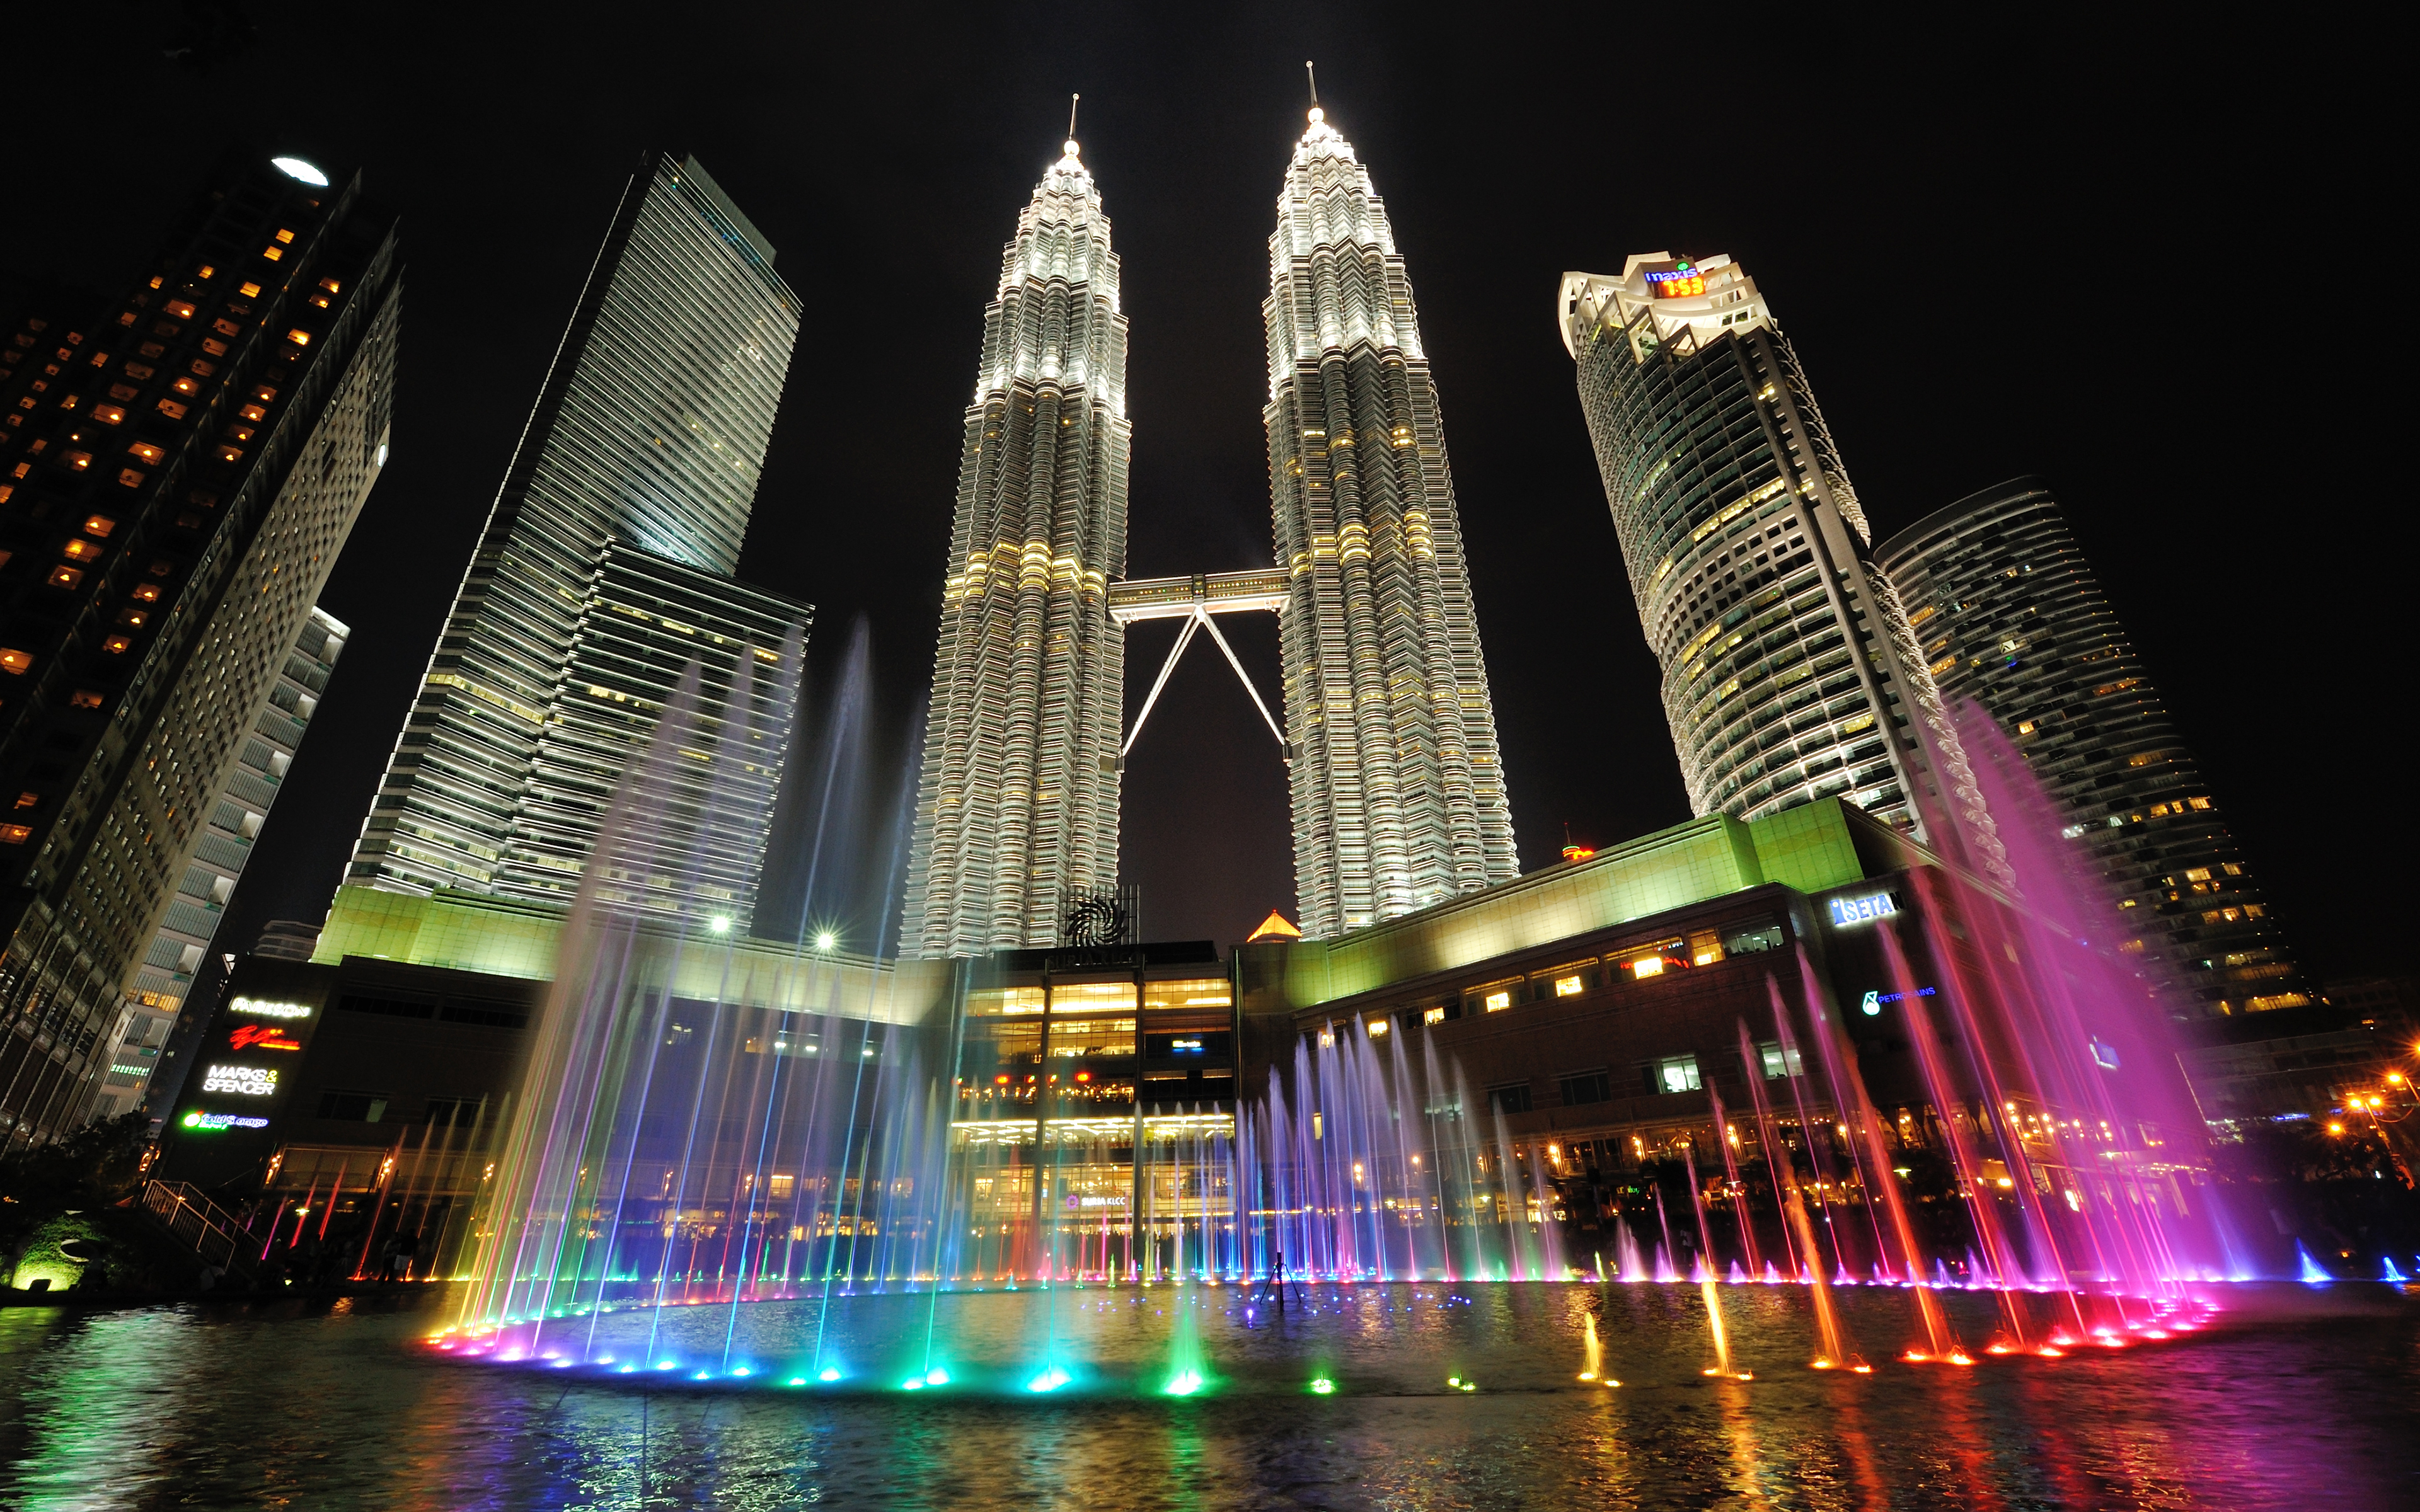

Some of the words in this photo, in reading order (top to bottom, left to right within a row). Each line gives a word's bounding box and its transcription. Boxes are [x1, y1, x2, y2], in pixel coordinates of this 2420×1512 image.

[1645, 268, 1698, 282] maxis
[1663, 277, 1703, 295] 7:53
[1878, 987, 1935, 1004] PETROSAINS
[231, 997, 311, 1017] PARKSON
[208, 1065, 267, 1082] MARKS
[265, 1070, 277, 1082] &
[203, 1078, 275, 1095] SPENCER
[201, 1114, 226, 1123] Cold
[226, 1115, 268, 1128] Sorage
[1107, 1197, 1126, 1205] KLCC
